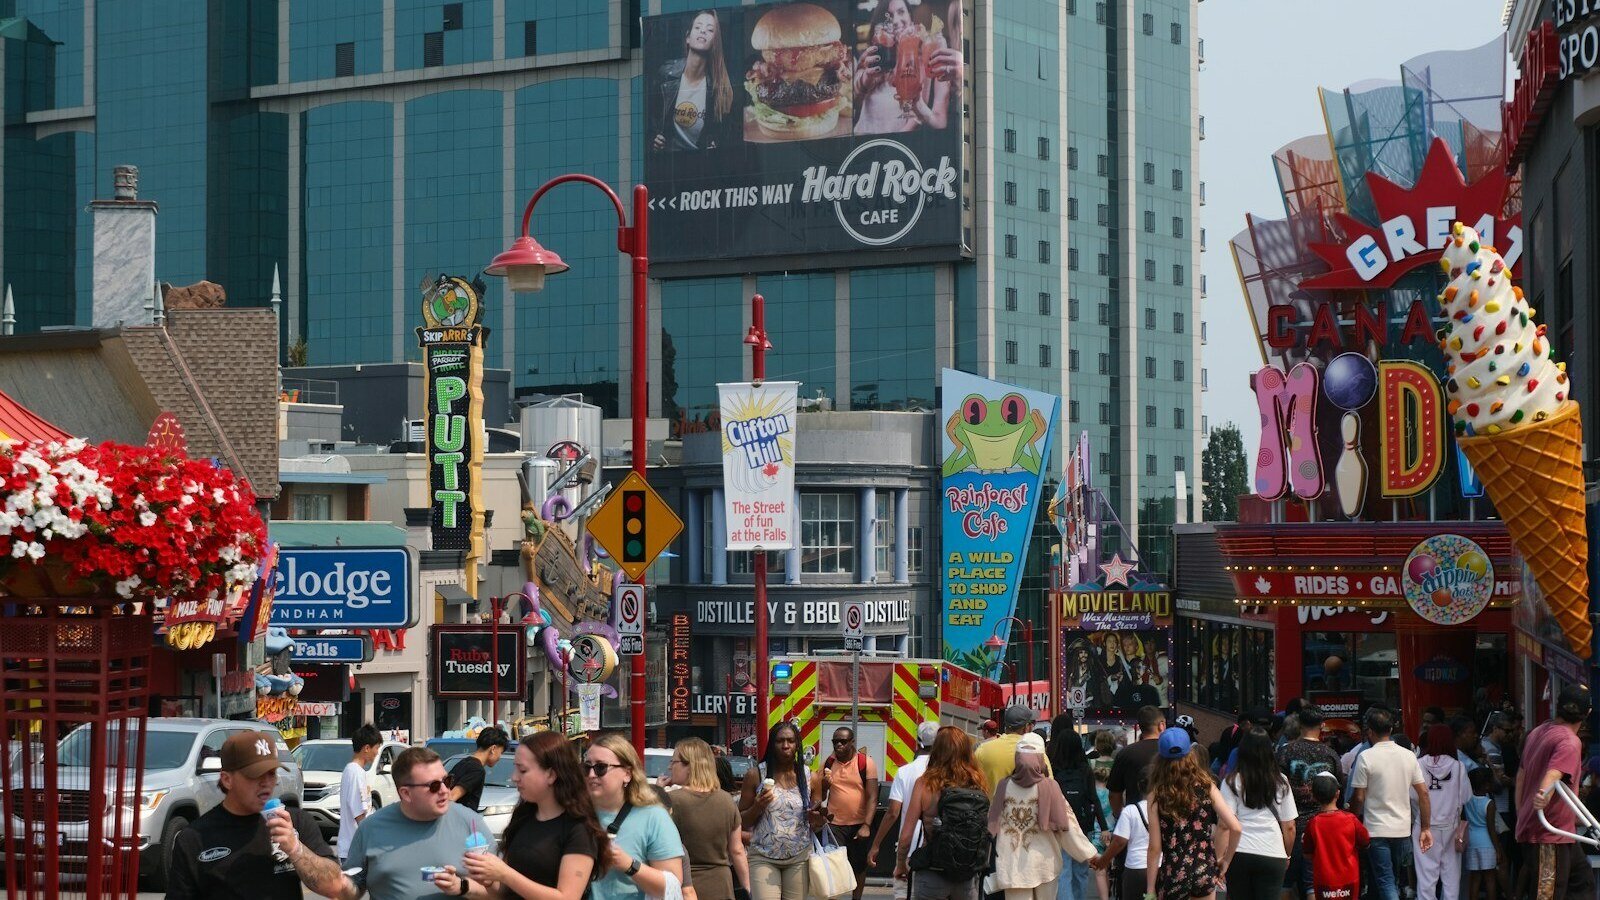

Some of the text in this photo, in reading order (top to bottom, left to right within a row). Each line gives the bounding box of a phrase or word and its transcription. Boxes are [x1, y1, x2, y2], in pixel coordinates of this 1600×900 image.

[1560, 25, 1598, 80] SPO
[801, 156, 957, 204] Hard Rock
[679, 183, 794, 212] ROCK THIS WAY
[860, 209, 899, 225] CAFE
[1268, 301, 1436, 348] CANA
[432, 356, 462, 365] PARROT
[726, 414, 789, 447] Clifton
[434, 376, 466, 529] PUTT
[743, 436, 783, 469] Hill
[946, 482, 1028, 514] Rainforest
[732, 501, 785, 514] The Street
[744, 515, 773, 528] of fun
[962, 508, 1008, 542] Cafe
[731, 528, 787, 541] at the Falls
[948, 552, 1014, 564] A WILD
[948, 567, 1006, 579] PLACE
[948, 583, 1008, 595] TO SHOP
[1294, 576, 1402, 595] RIDES GA
[948, 599, 988, 611] AND
[1063, 592, 1169, 619] MOVIELAND
[270, 609, 343, 619] YNDHAM
[697, 601, 841, 625] DISTILLEY & BBQ
[948, 614, 984, 626] EAT
[1082, 612, 1151, 624] Wax Museum of
[1094, 622, 1138, 630] The Stars
[295, 642, 338, 657] Falls
[450, 649, 490, 662] Ruby
[295, 704, 331, 716] ANCY
[736, 695, 747, 714] &
[1322, 889, 1351, 898] wefox
